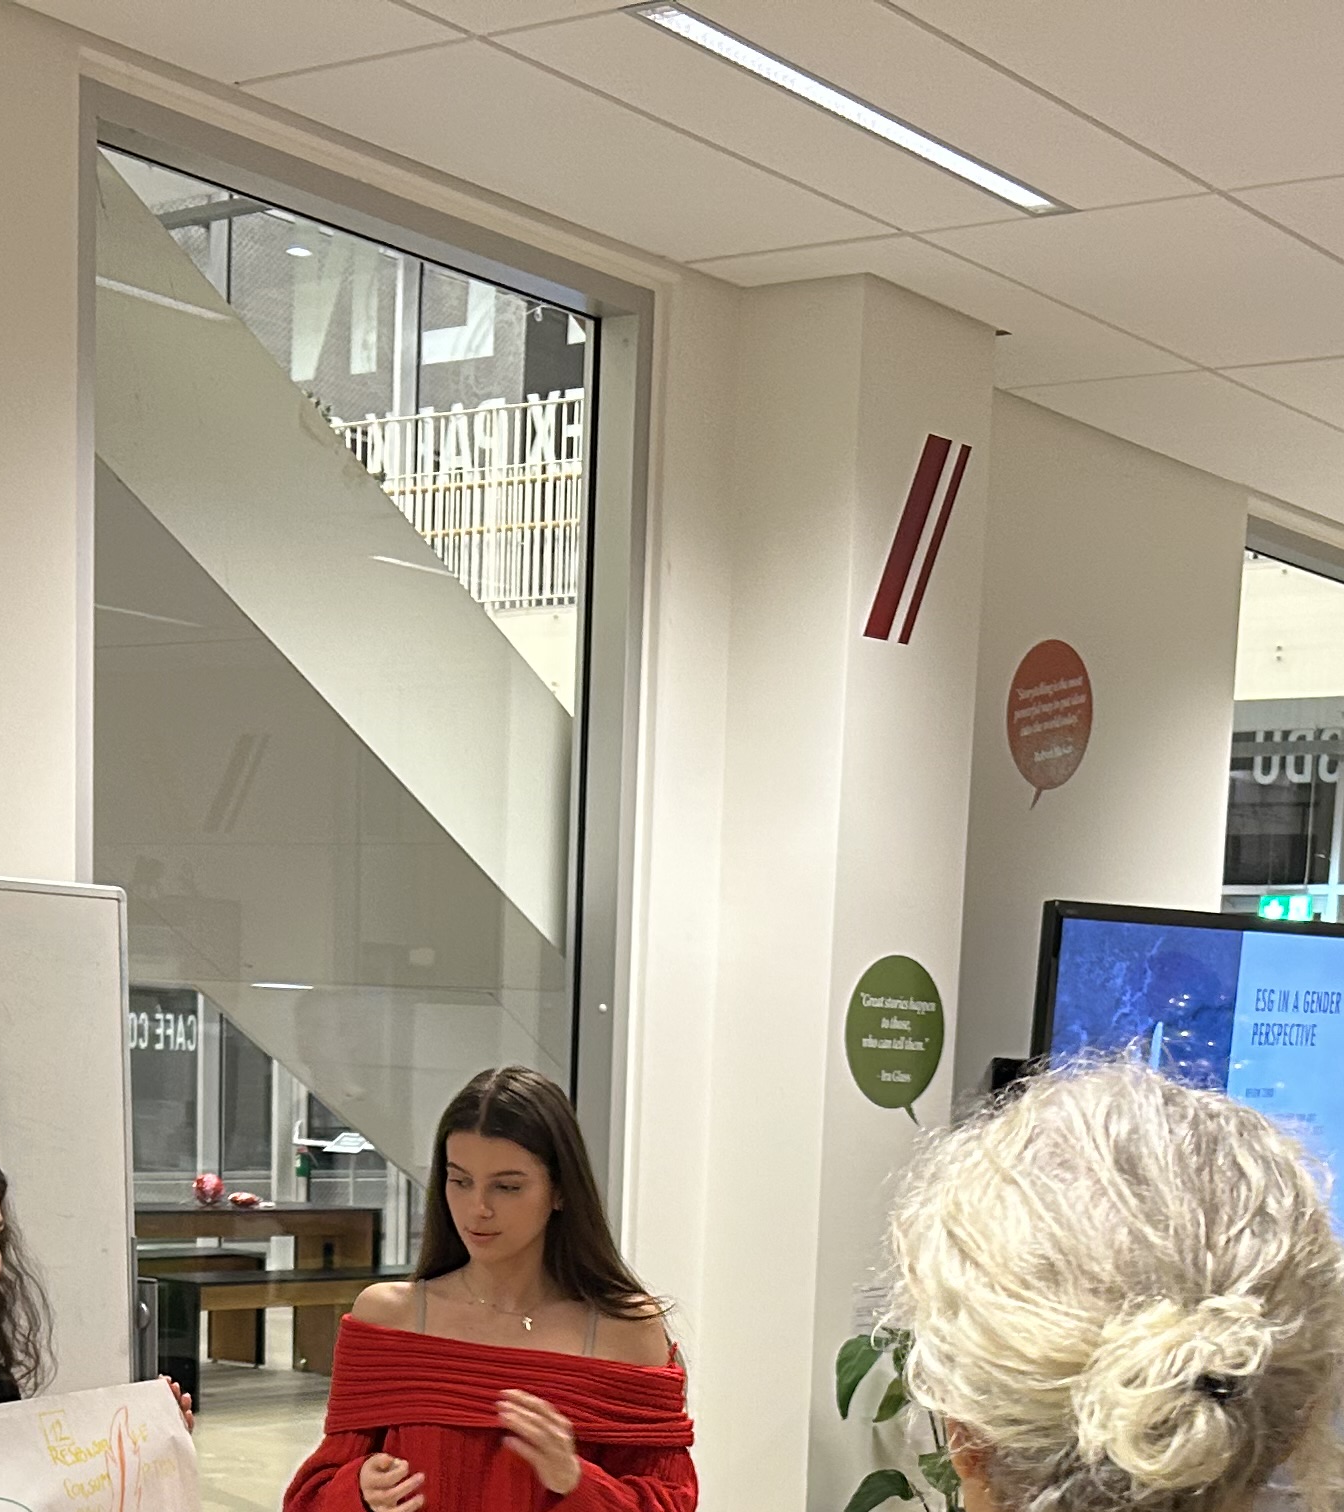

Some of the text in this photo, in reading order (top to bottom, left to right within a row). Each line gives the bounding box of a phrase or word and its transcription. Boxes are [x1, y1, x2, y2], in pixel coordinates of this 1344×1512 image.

[1254, 988, 1342, 1014] ESG IN A GENDER
[1251, 1022, 1318, 1046] PERSPECTIVE
